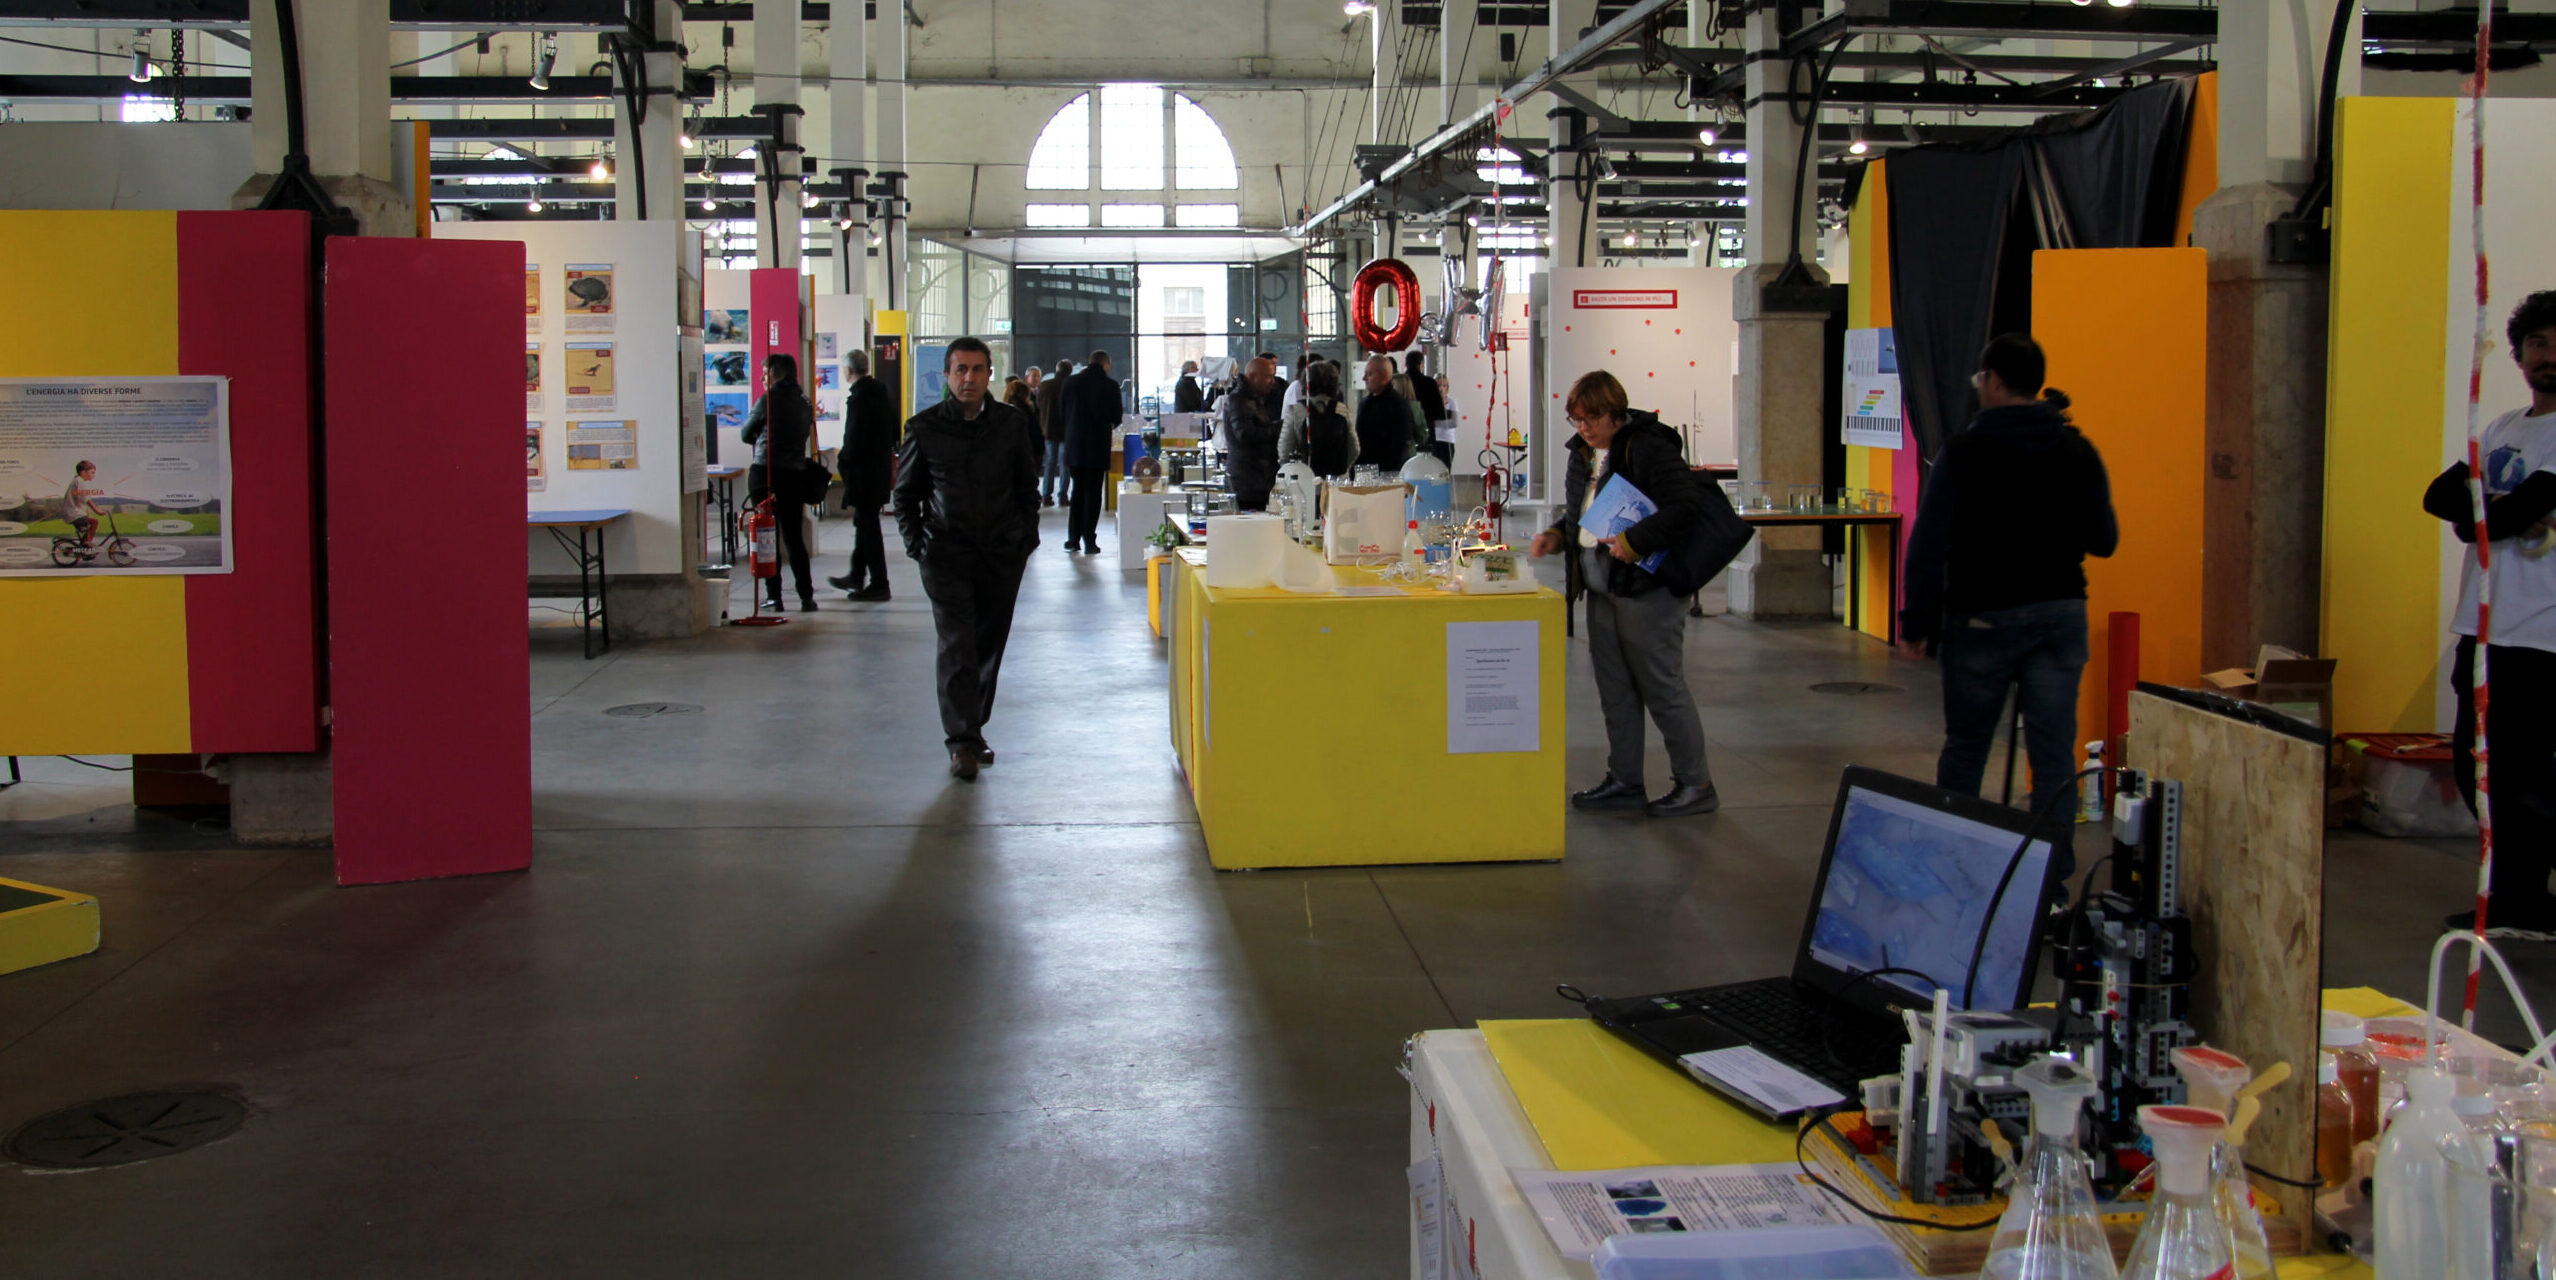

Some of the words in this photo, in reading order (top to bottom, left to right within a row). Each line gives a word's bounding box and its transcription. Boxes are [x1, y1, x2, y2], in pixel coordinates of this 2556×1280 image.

[26, 387, 66, 396] L'ENERGIA
[67, 387, 79, 395] HA
[80, 387, 113, 395] DIVERSE
[115, 387, 142, 395] FORME
